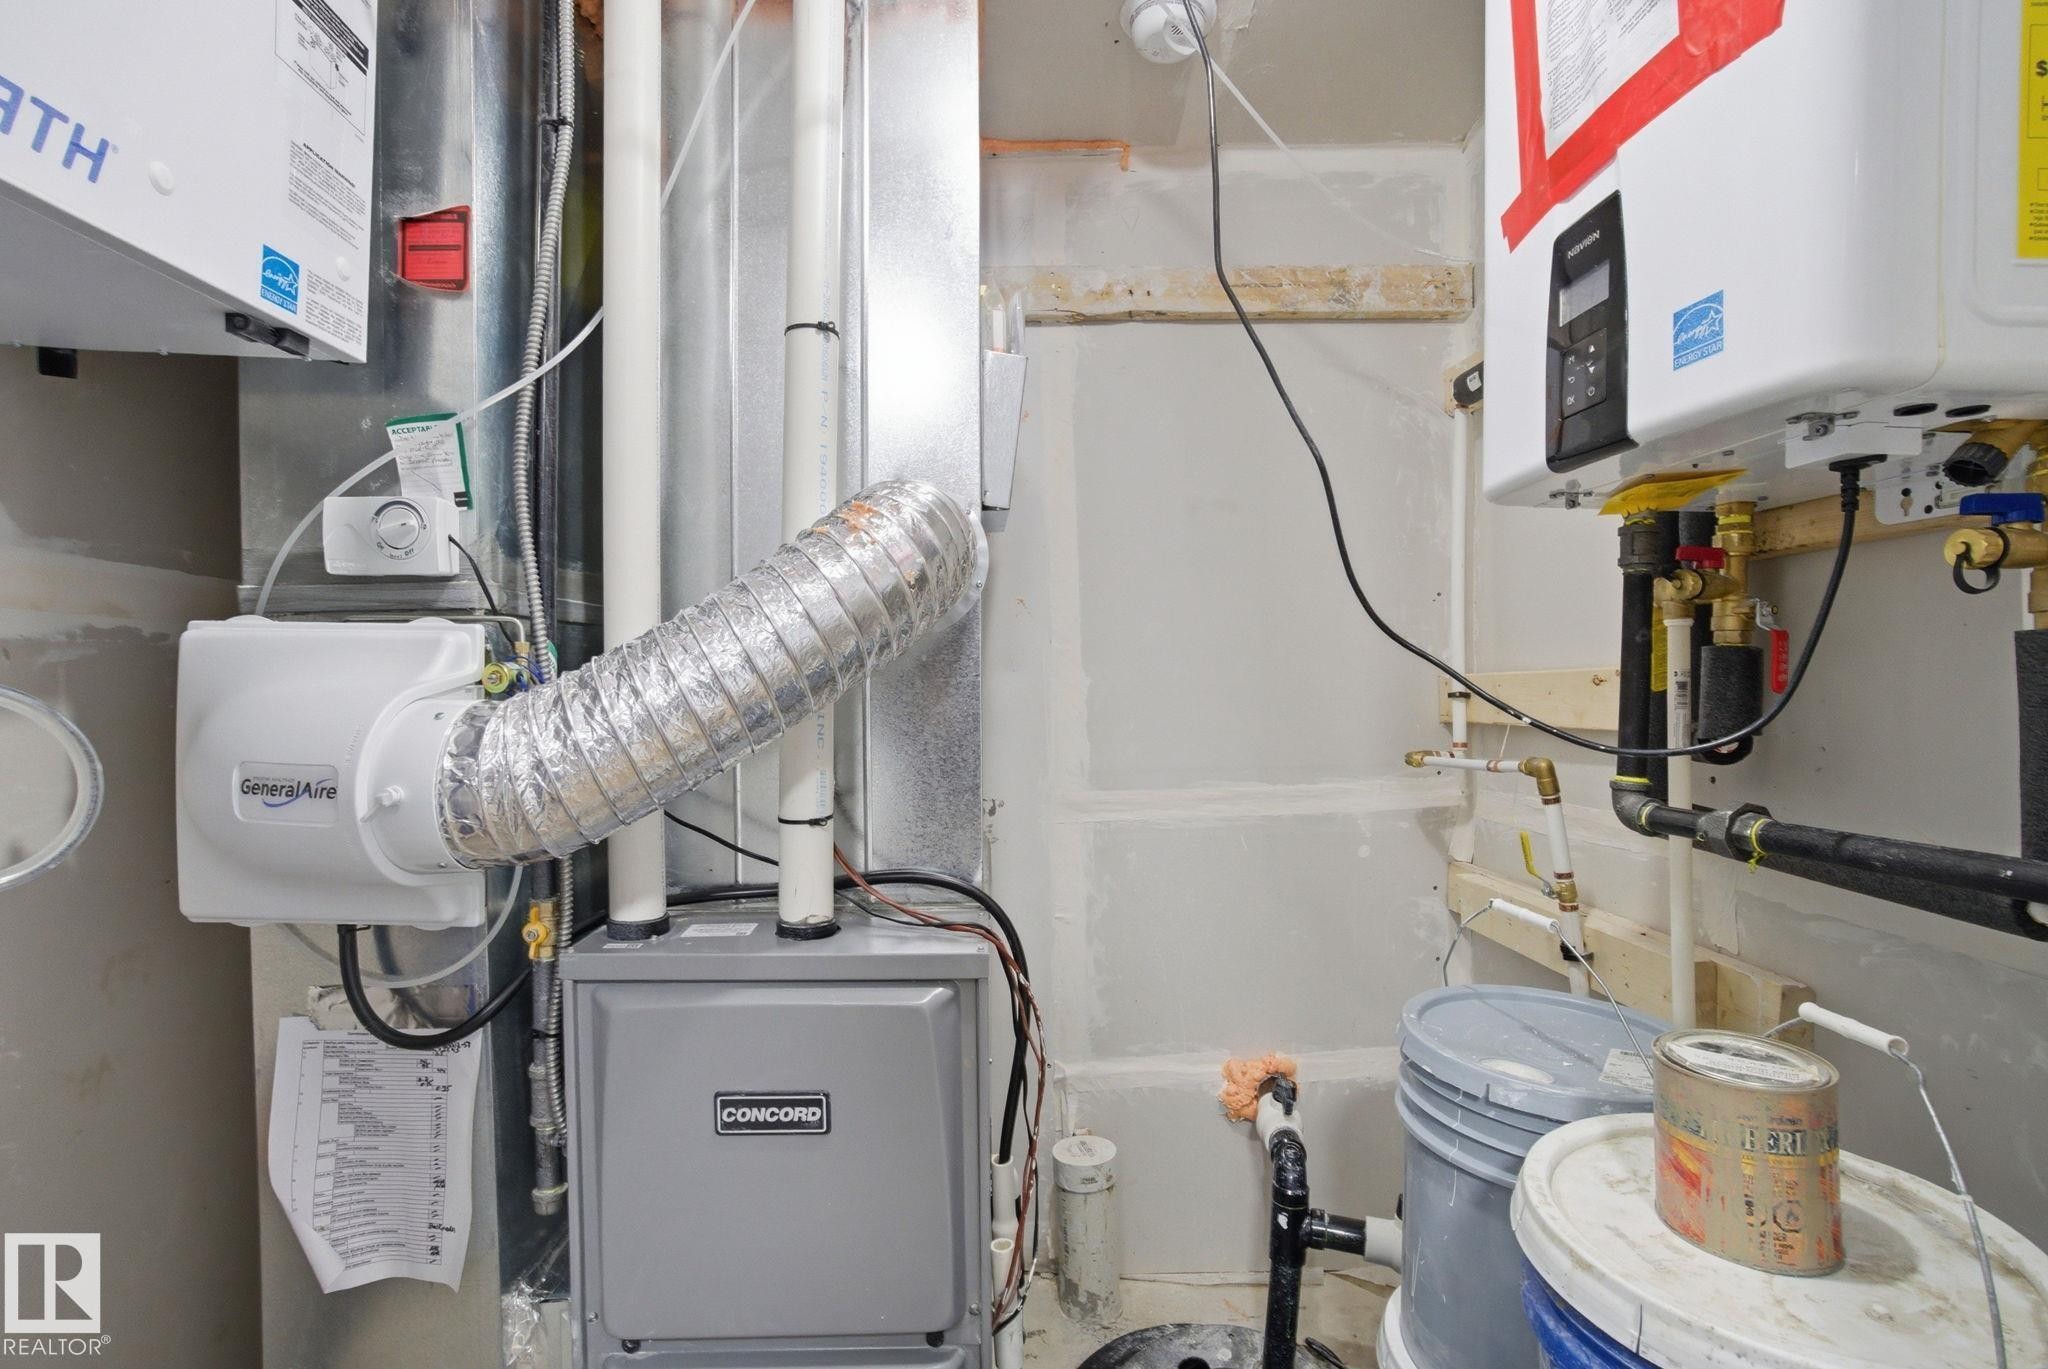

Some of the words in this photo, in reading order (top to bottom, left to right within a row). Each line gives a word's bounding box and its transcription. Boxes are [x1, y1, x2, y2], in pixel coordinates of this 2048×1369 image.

[1674, 351, 1701, 368] ENERGY
[1703, 341, 1723, 357] STAR
[240, 778, 337, 800] GeneralAire
[721, 1106, 822, 1123] CONCORD
